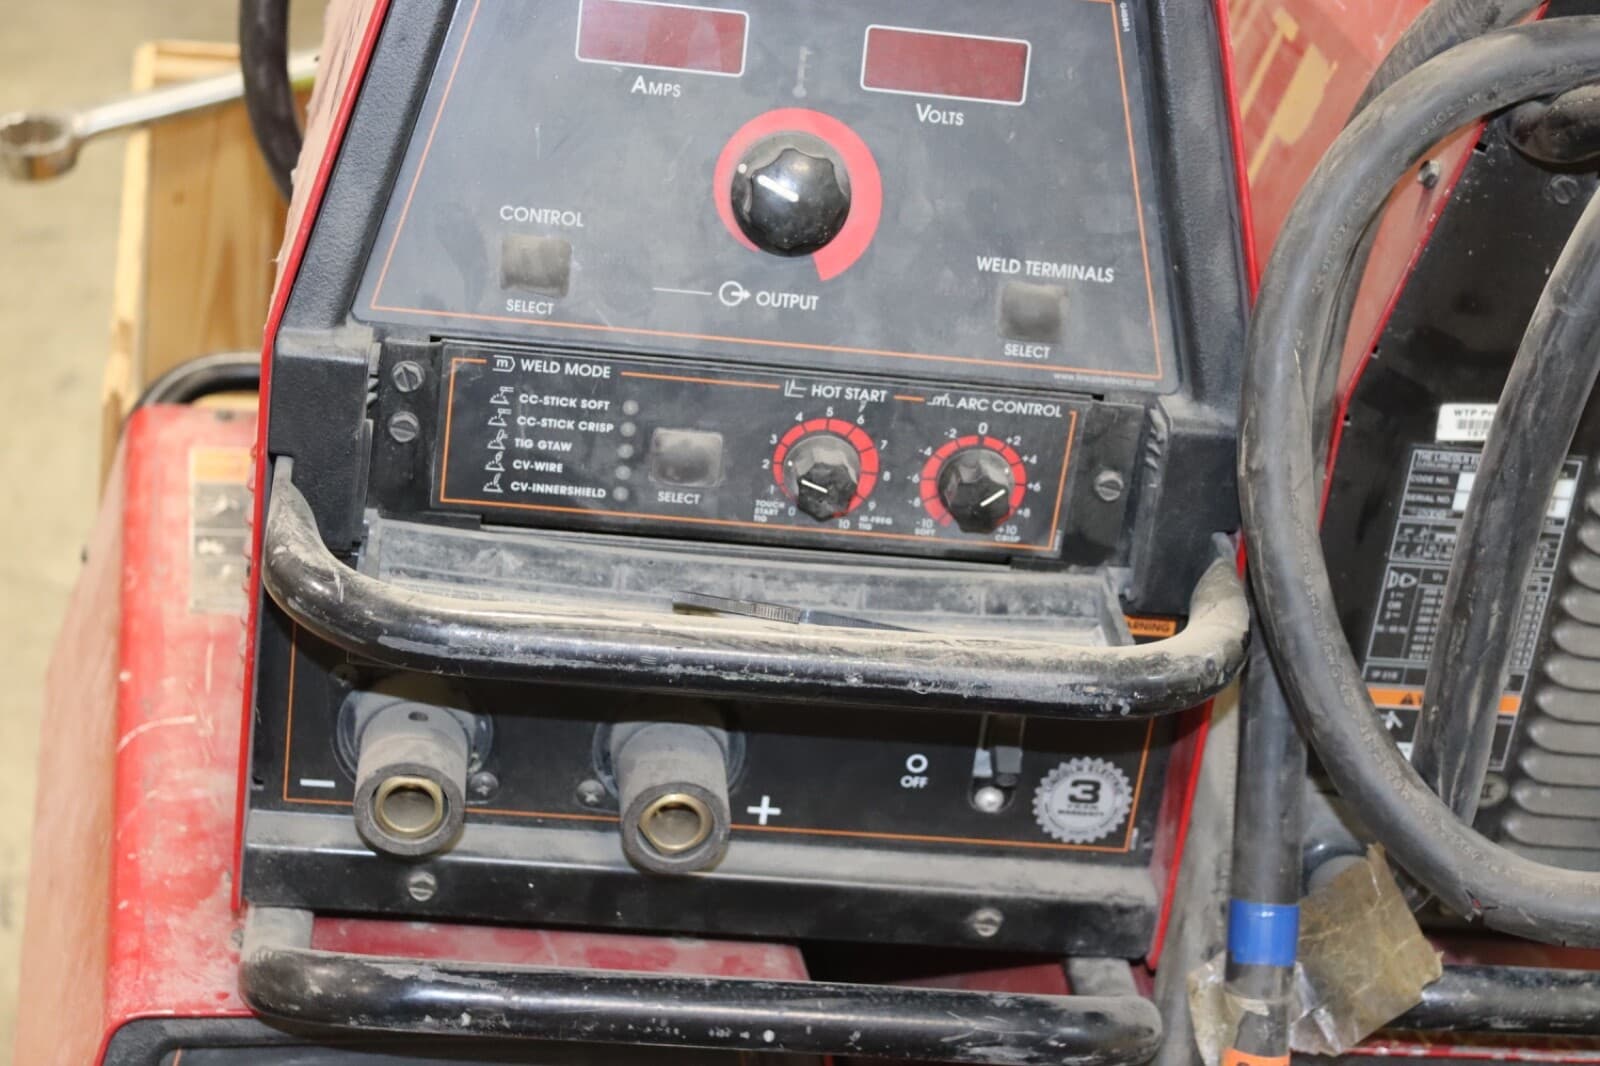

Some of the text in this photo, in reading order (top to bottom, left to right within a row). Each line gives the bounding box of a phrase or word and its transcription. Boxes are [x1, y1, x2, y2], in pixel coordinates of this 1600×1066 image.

[499, 205, 584, 228] CONTROL
[976, 255, 1115, 283] WELD TERMINALS
[755, 291, 819, 311] OUTPUT
[505, 298, 554, 316] SELECT
[1004, 343, 1051, 360] SELECT
[520, 358, 612, 379] WELD MODE
[811, 384, 888, 403] HOT START
[518, 393, 611, 411] CC-STICK SOFT
[956, 397, 1062, 418] ARC CONTROL
[795, 412, 803, 421] 4
[826, 407, 834, 417] 5
[516, 416, 615, 433] CC-STICK CRISP
[856, 415, 865, 425] 6
[944, 428, 957, 438] -2
[978, 422, 988, 435] 0
[769, 434, 777, 444] 3
[880, 440, 888, 449] 7
[1006, 435, 1022, 446] +2
[514, 438, 573, 452] TIG GTAW
[918, 446, 932, 456] -4
[762, 459, 770, 469] 2
[1022, 454, 1038, 465] +4
[512, 459, 564, 474] CV-WIRE
[883, 471, 891, 481] 8
[906, 473, 920, 484] -6
[510, 481, 607, 499] CV-INNERSHIELD
[1027, 482, 1041, 492] +6
[657, 490, 702, 505] SELECT
[754, 499, 785, 508] TOUCH
[868, 501, 876, 511] 9
[754, 507, 779, 516] START
[788, 507, 796, 516] 0
[753, 515, 768, 523] TIG
[838, 519, 850, 529] 10
[916, 518, 934, 529] -10
[998, 525, 1018, 535] +10
[900, 774, 929, 789] OFF
[1068, 779, 1101, 804] 3
